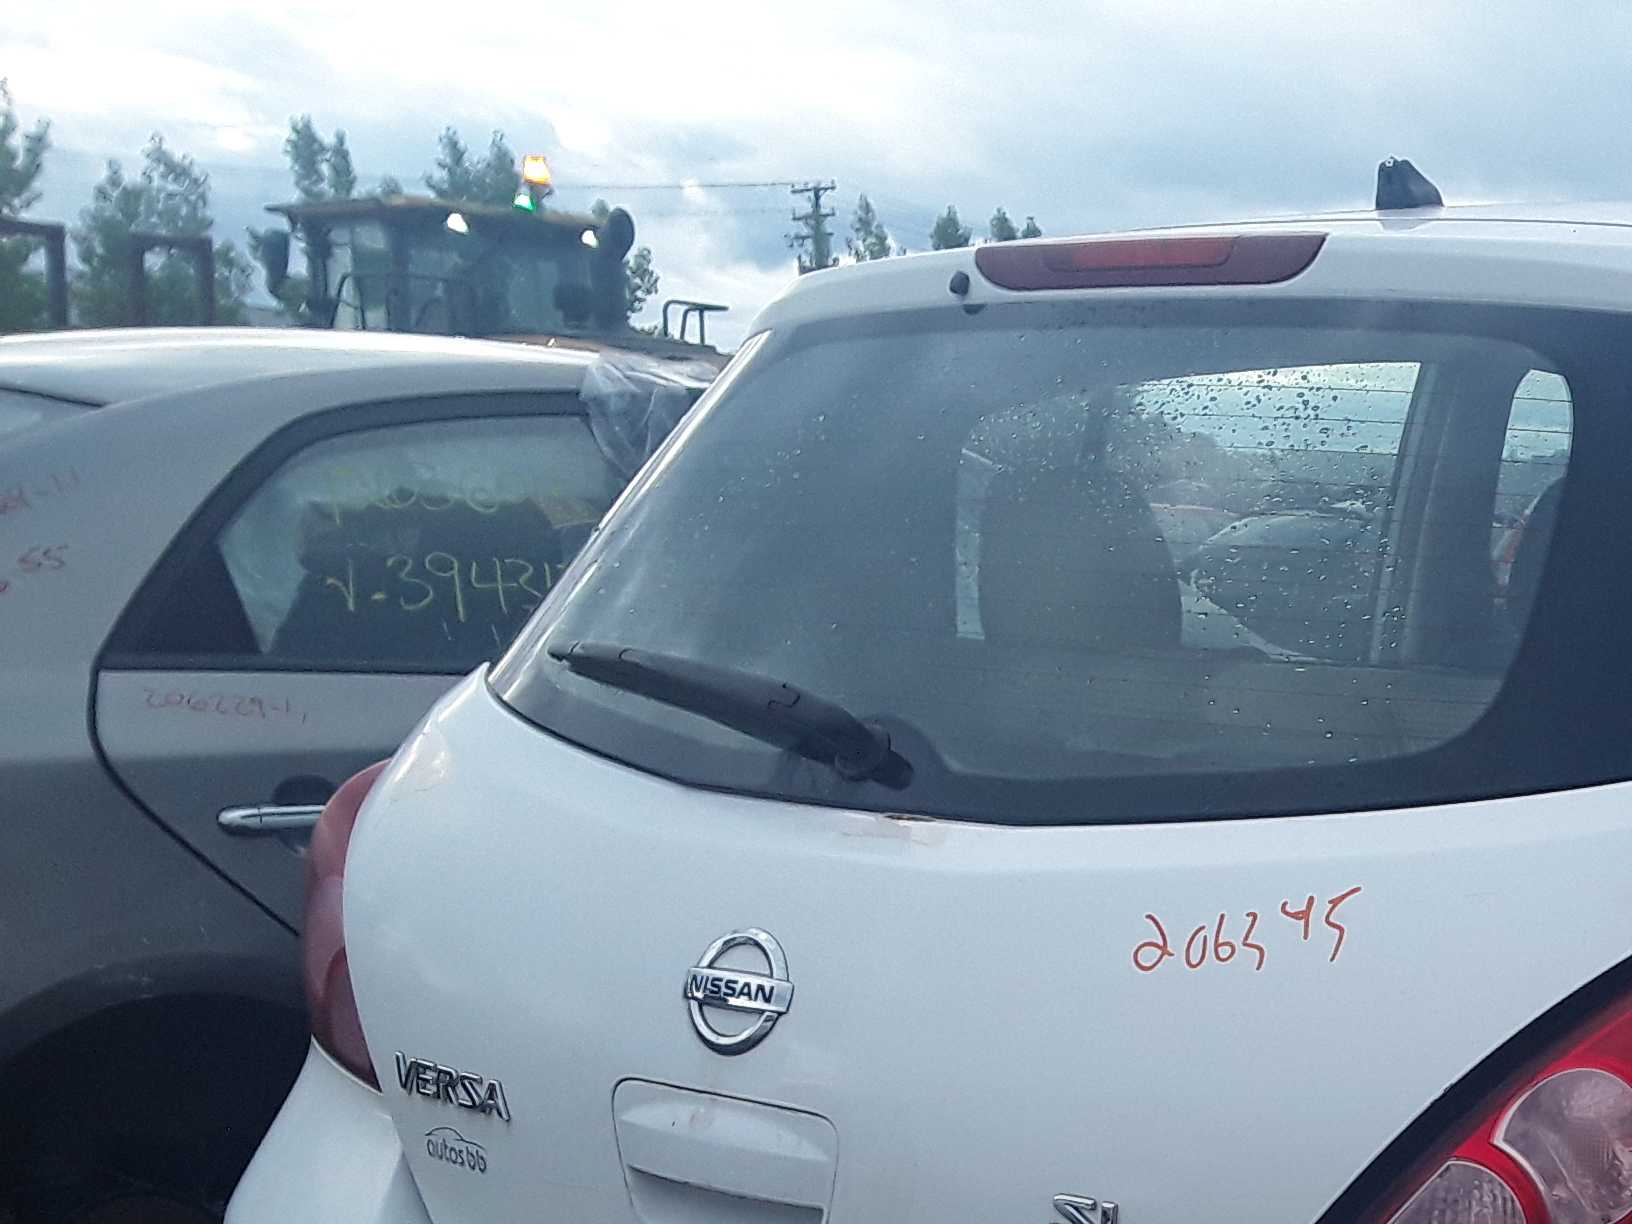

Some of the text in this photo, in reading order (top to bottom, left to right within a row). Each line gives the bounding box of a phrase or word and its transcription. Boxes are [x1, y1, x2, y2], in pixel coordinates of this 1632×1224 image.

[1133, 886, 1362, 972] 206345
[688, 974, 776, 1005] NISSAN
[394, 1049, 512, 1123] VERSA
